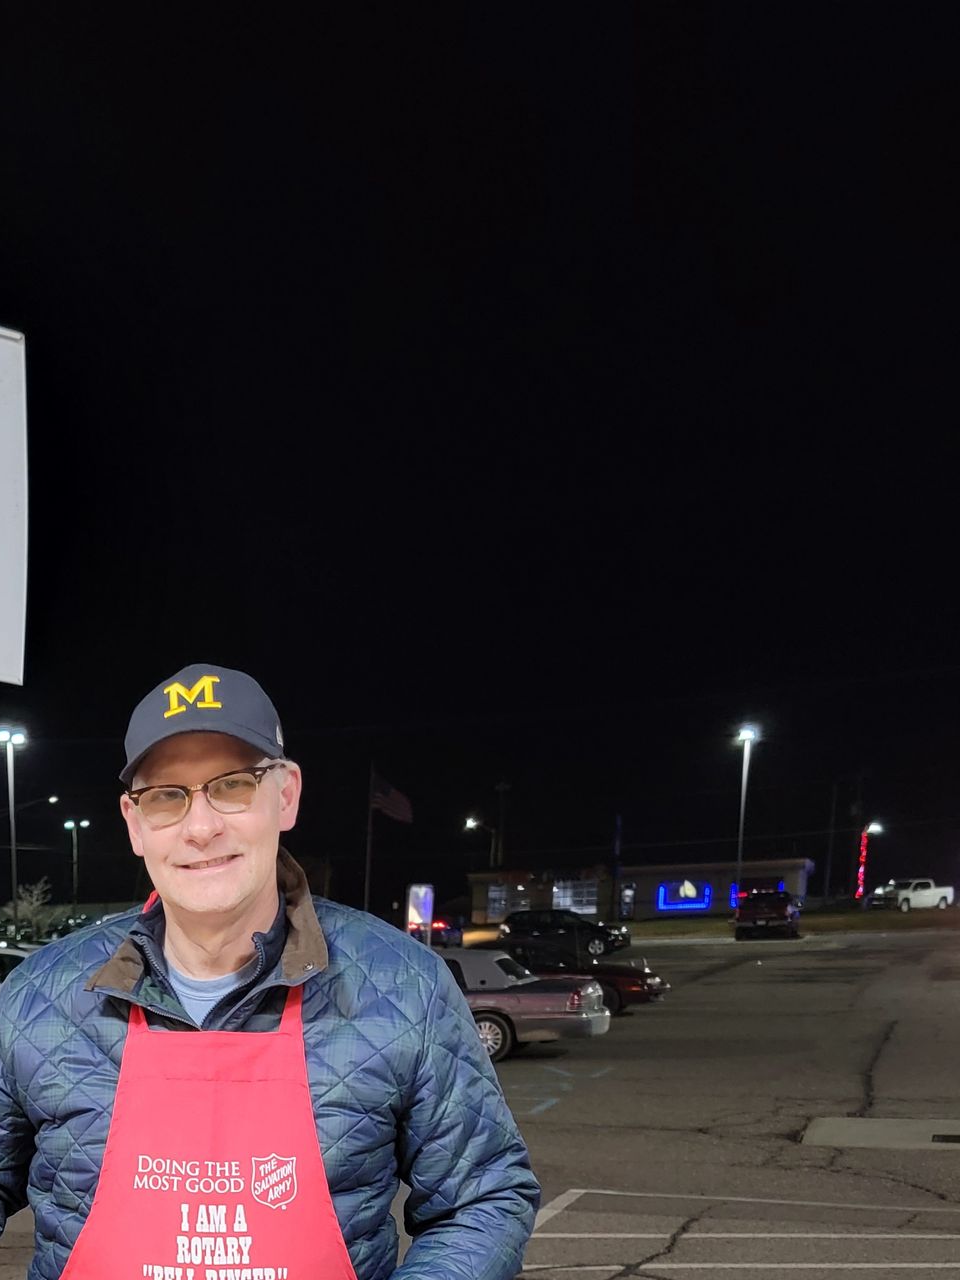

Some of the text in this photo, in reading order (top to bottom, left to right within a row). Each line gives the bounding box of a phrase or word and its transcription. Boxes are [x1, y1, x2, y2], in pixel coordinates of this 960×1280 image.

[163, 675, 223, 719] M
[138, 1155, 240, 1177] DOING THE
[254, 1161, 293, 1196] SALVATION
[259, 1158, 278, 1177] THE
[133, 1174, 245, 1194] MOST GOOD
[267, 1177, 292, 1203] ARMY
[180, 1203, 248, 1233] I AM A
[176, 1235, 253, 1265] ROTARY
